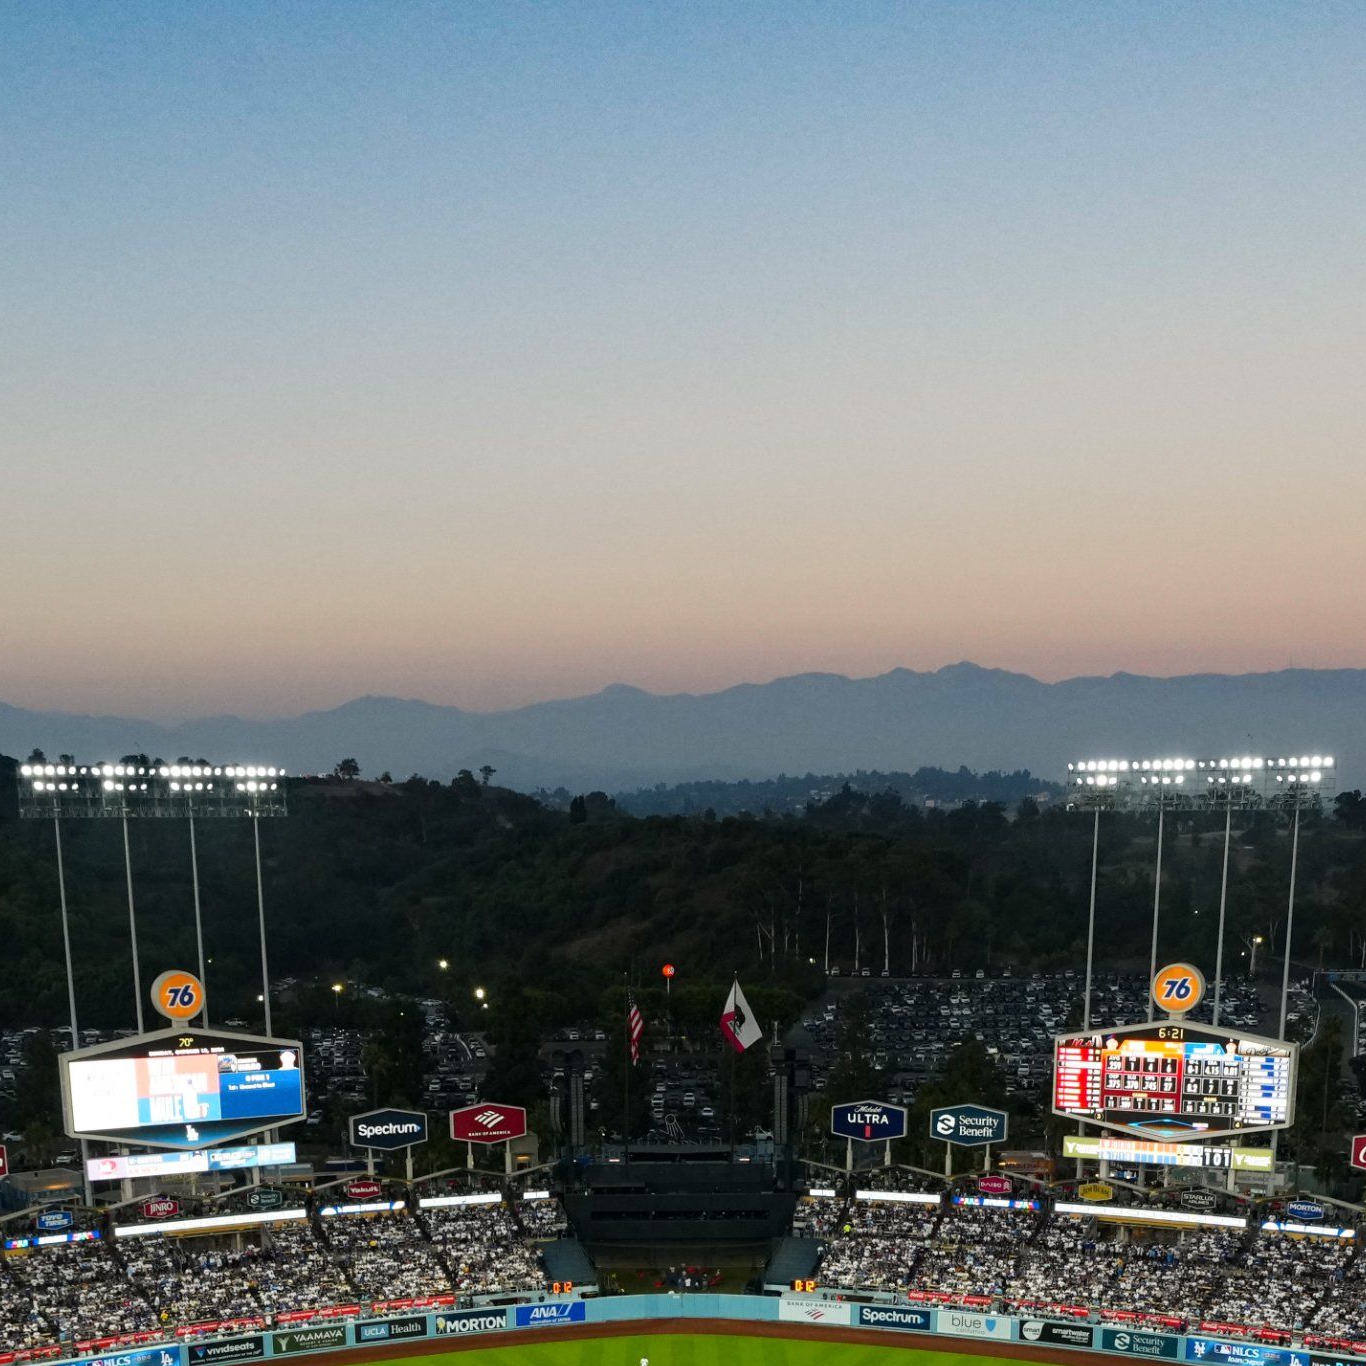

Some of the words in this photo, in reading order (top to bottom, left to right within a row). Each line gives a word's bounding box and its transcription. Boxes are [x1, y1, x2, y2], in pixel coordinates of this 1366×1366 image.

[1162, 977, 1193, 1000] 76
[166, 984, 196, 1008] 76
[1158, 1027, 1184, 1039] 6:21
[847, 1113, 889, 1125] ULTRA
[958, 1115, 999, 1128] Security
[357, 1122, 418, 1138] Spectrum
[958, 1126, 993, 1138] Benefit
[1213, 1152, 1222, 1166] 0
[349, 1186, 379, 1194] Yakult
[1183, 1193, 1214, 1202] STARLUX
[150, 1202, 174, 1215] JINRO
[1289, 1203, 1322, 1213] MORTON
[553, 1281, 573, 1294] 0:12
[794, 1280, 815, 1292] 0:12
[530, 1304, 558, 1319] ANA
[862, 1308, 922, 1324] Spectrum
[446, 1315, 507, 1333] MORTON
[951, 1314, 981, 1328] blue
[364, 1327, 385, 1337] UCLA
[391, 1322, 421, 1334] Health
[1052, 1327, 1090, 1338] smartwater
[1132, 1334, 1165, 1346] Security
[1132, 1344, 1160, 1355] Benefit
[1232, 1346, 1260, 1358] NLCS
[160, 1350, 173, 1366] LA
